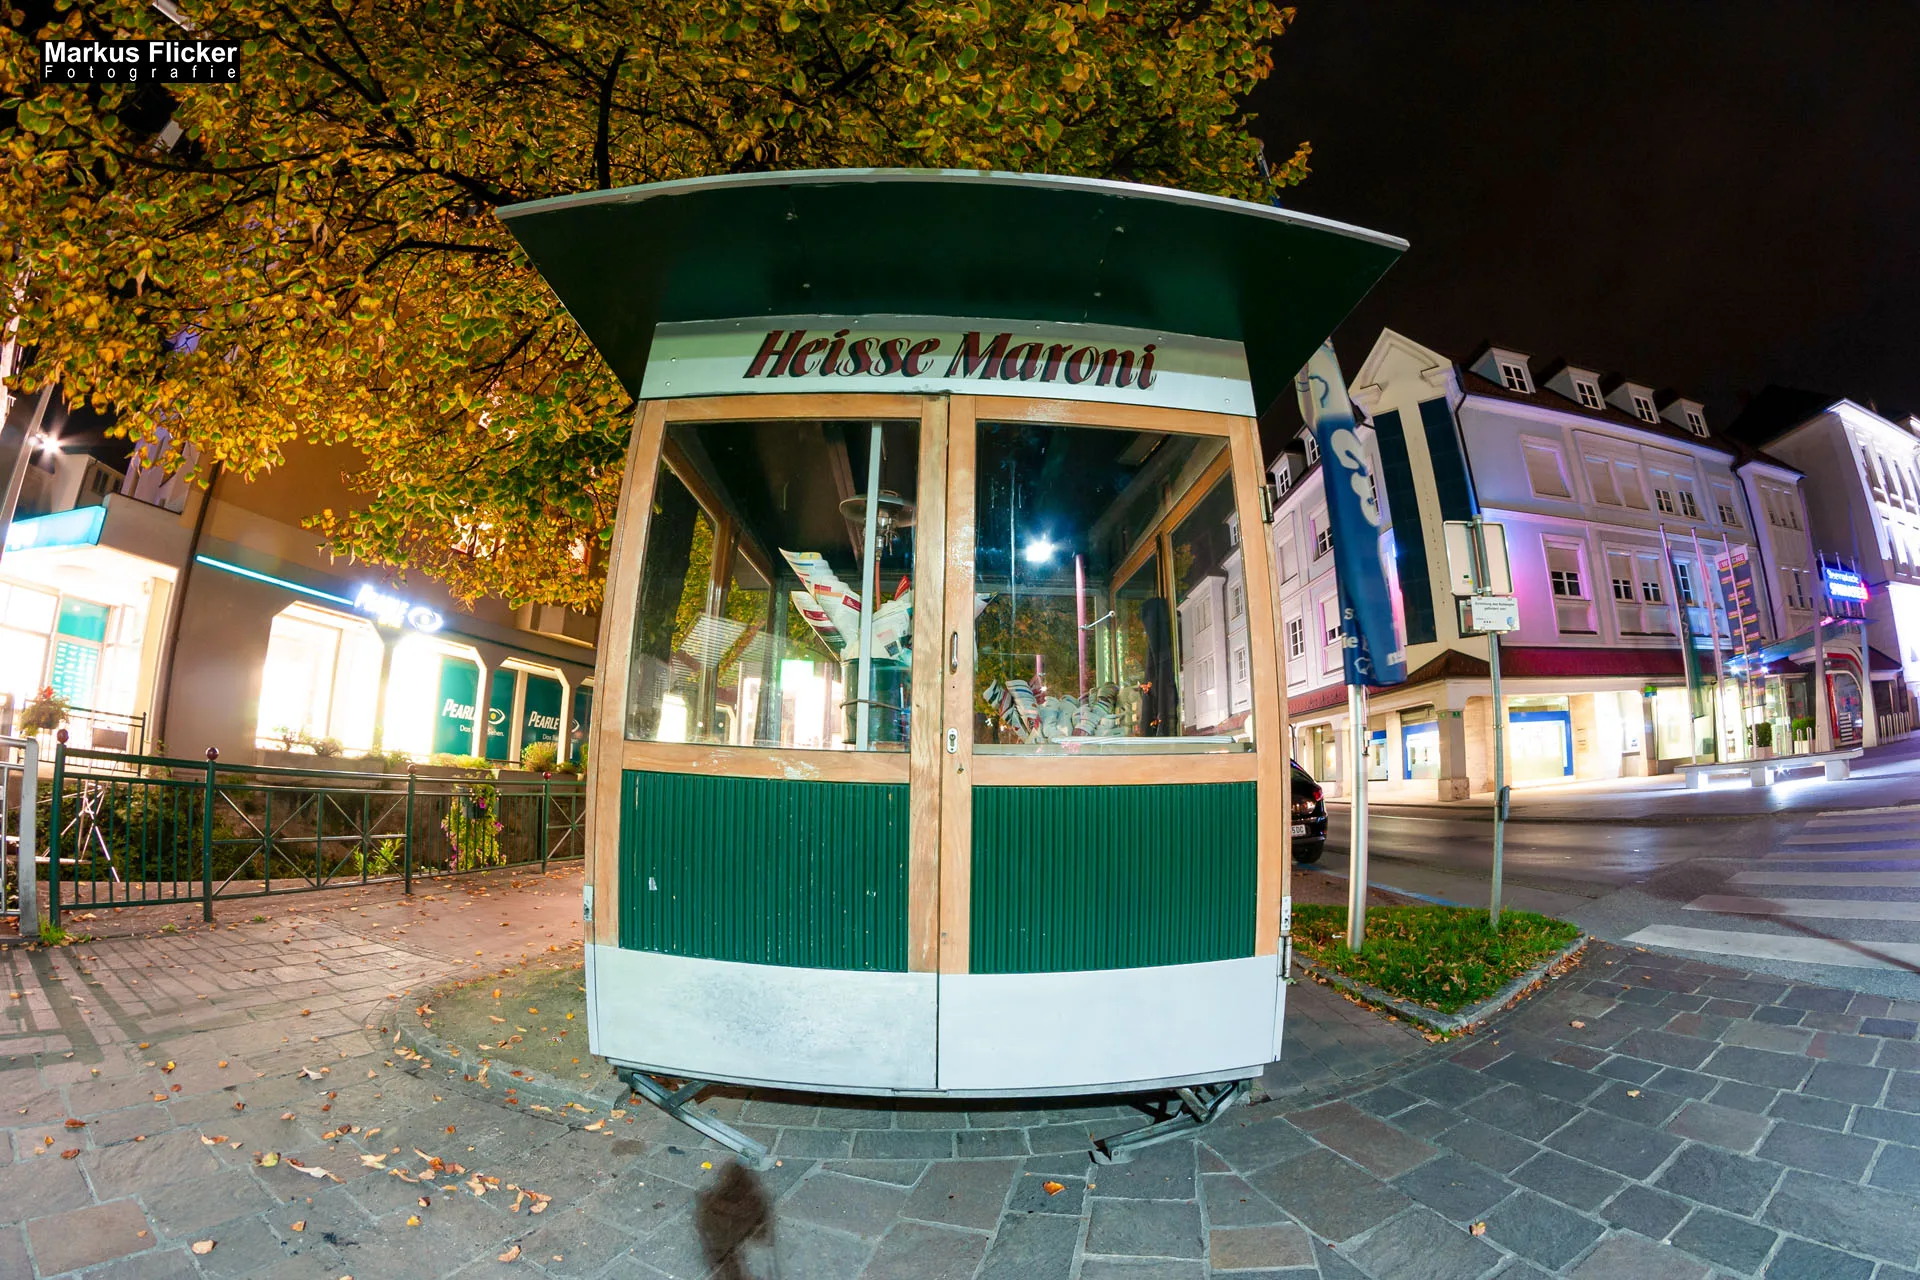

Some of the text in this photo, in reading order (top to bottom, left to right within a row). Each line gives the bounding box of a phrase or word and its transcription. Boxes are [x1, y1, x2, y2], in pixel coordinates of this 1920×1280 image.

[742, 329, 1158, 391] Heisse Maroni
[528, 711, 560, 730] PEARLE
